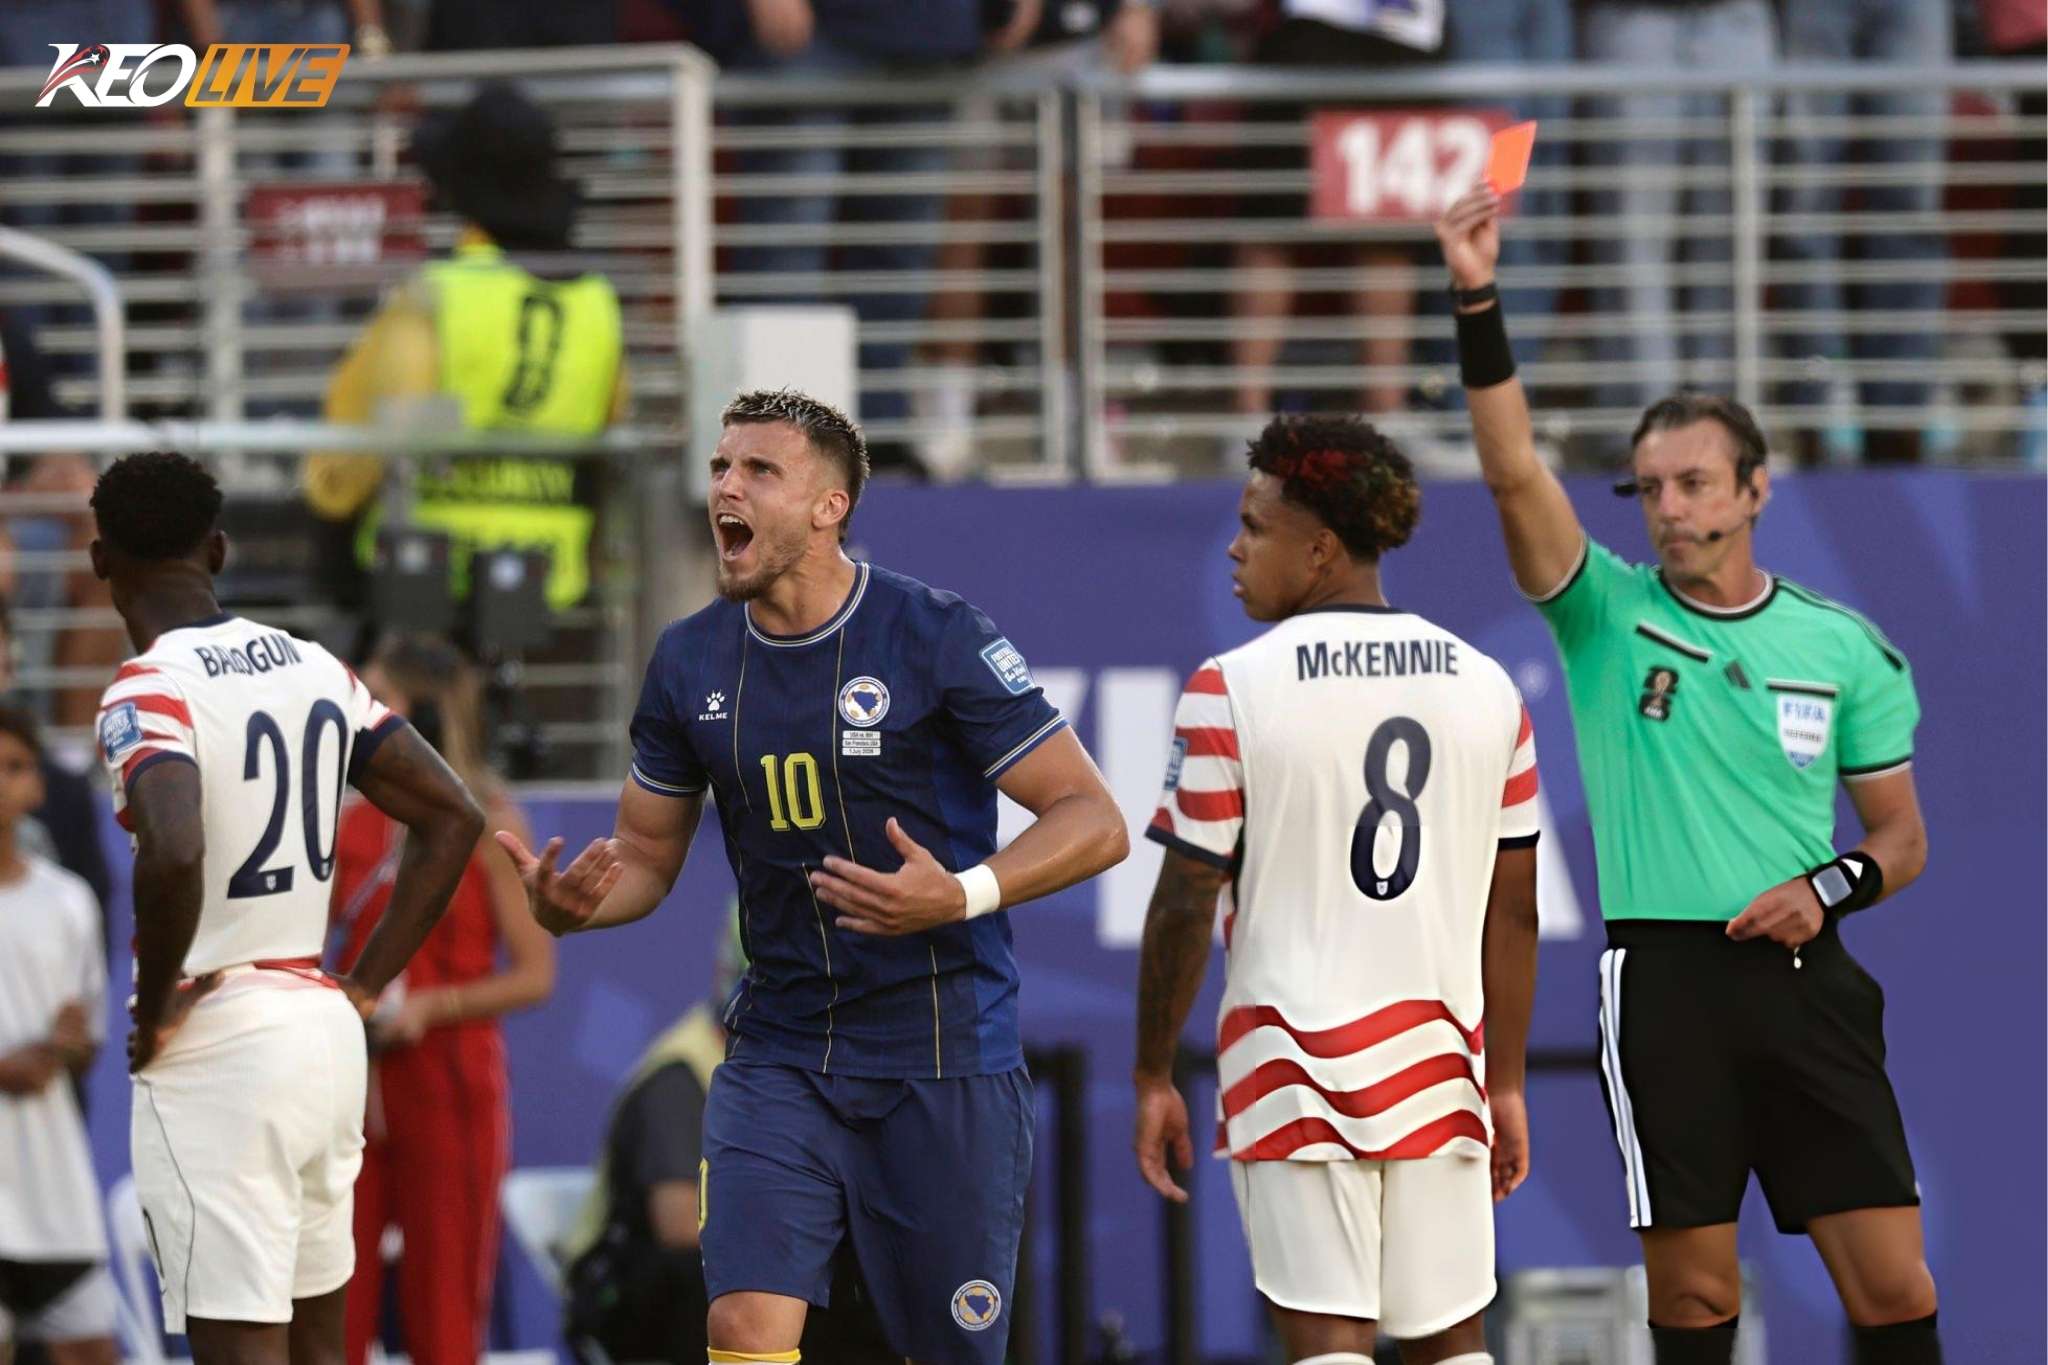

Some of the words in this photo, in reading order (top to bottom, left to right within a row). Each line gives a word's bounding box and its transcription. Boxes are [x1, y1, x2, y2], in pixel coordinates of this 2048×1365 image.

[1337, 116, 1490, 214] 142
[1296, 640, 1459, 681] McKENNIE
[698, 712, 728, 721] KELME
[226, 697, 349, 899] 20
[760, 752, 827, 832] 10
[1350, 715, 1432, 901] 8
